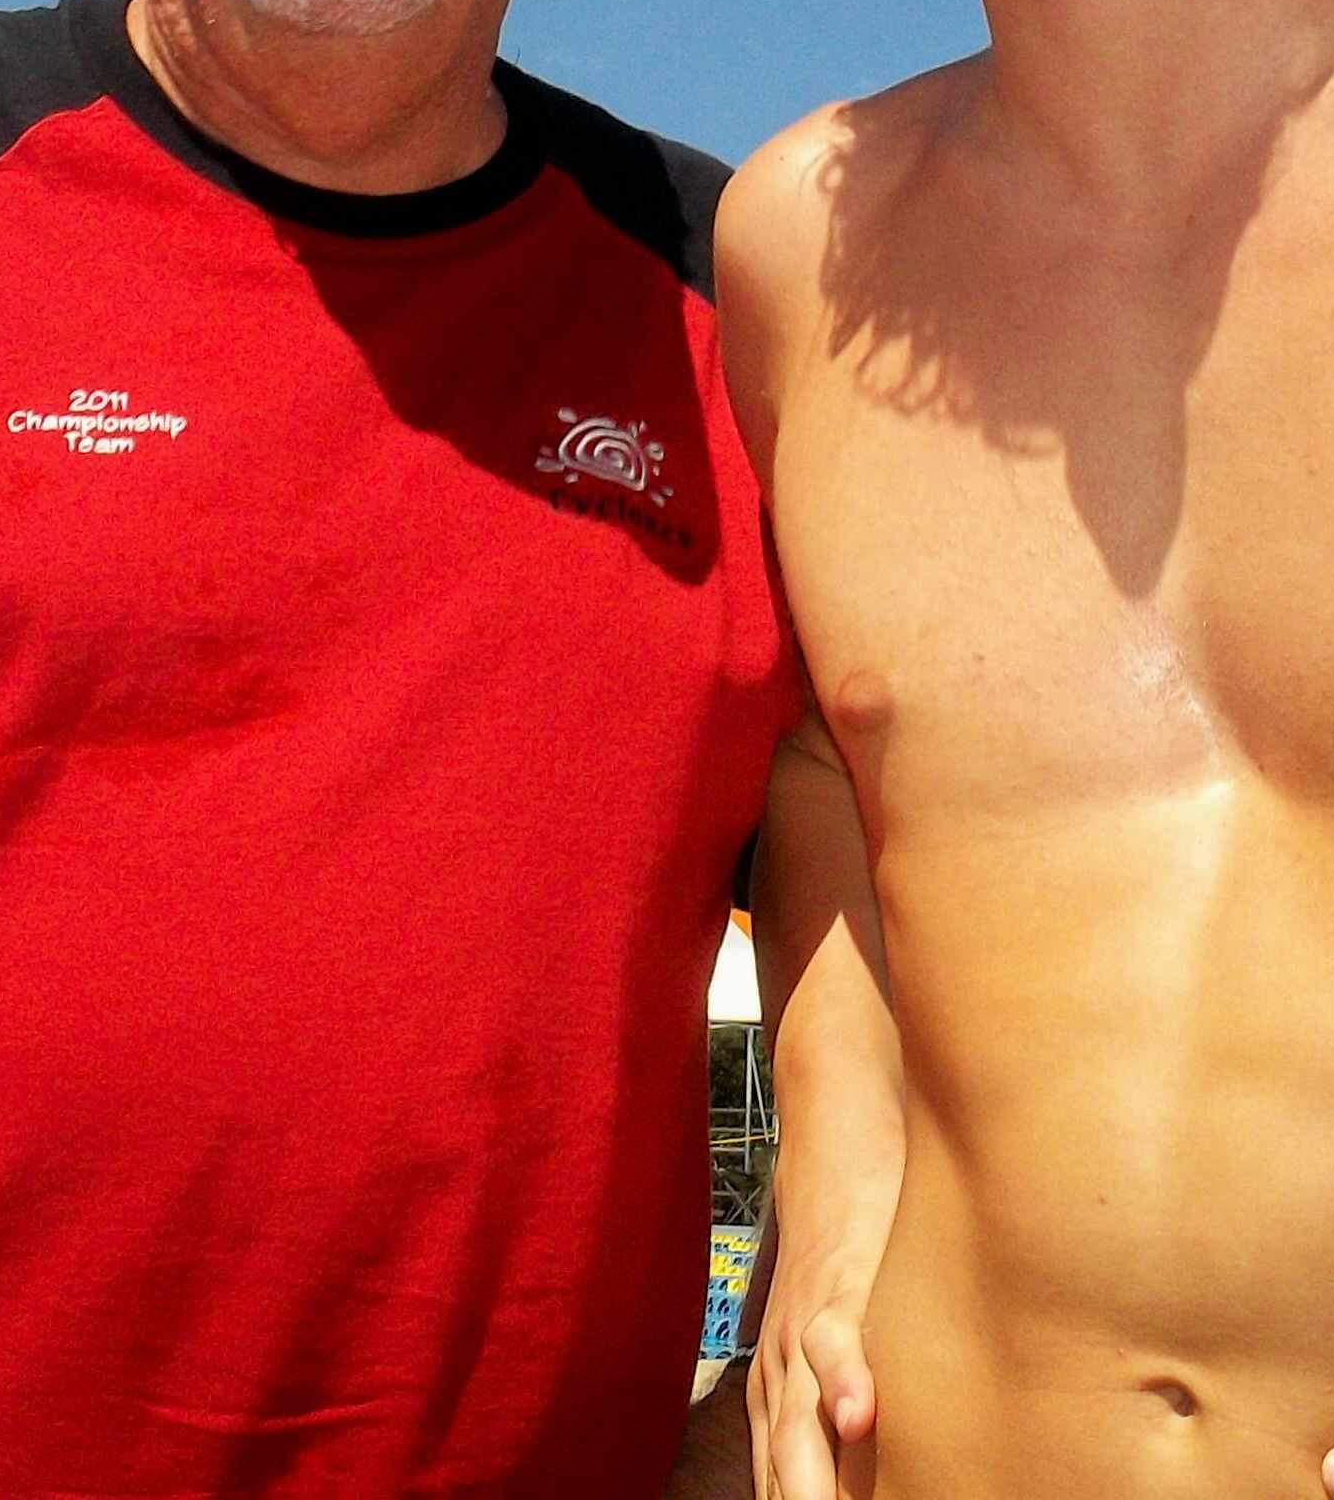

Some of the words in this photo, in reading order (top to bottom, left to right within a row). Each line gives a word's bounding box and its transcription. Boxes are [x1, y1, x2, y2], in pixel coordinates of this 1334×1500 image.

[68, 388, 130, 412] 2011
[7, 409, 188, 440] Championship
[64, 431, 136, 454] Team
